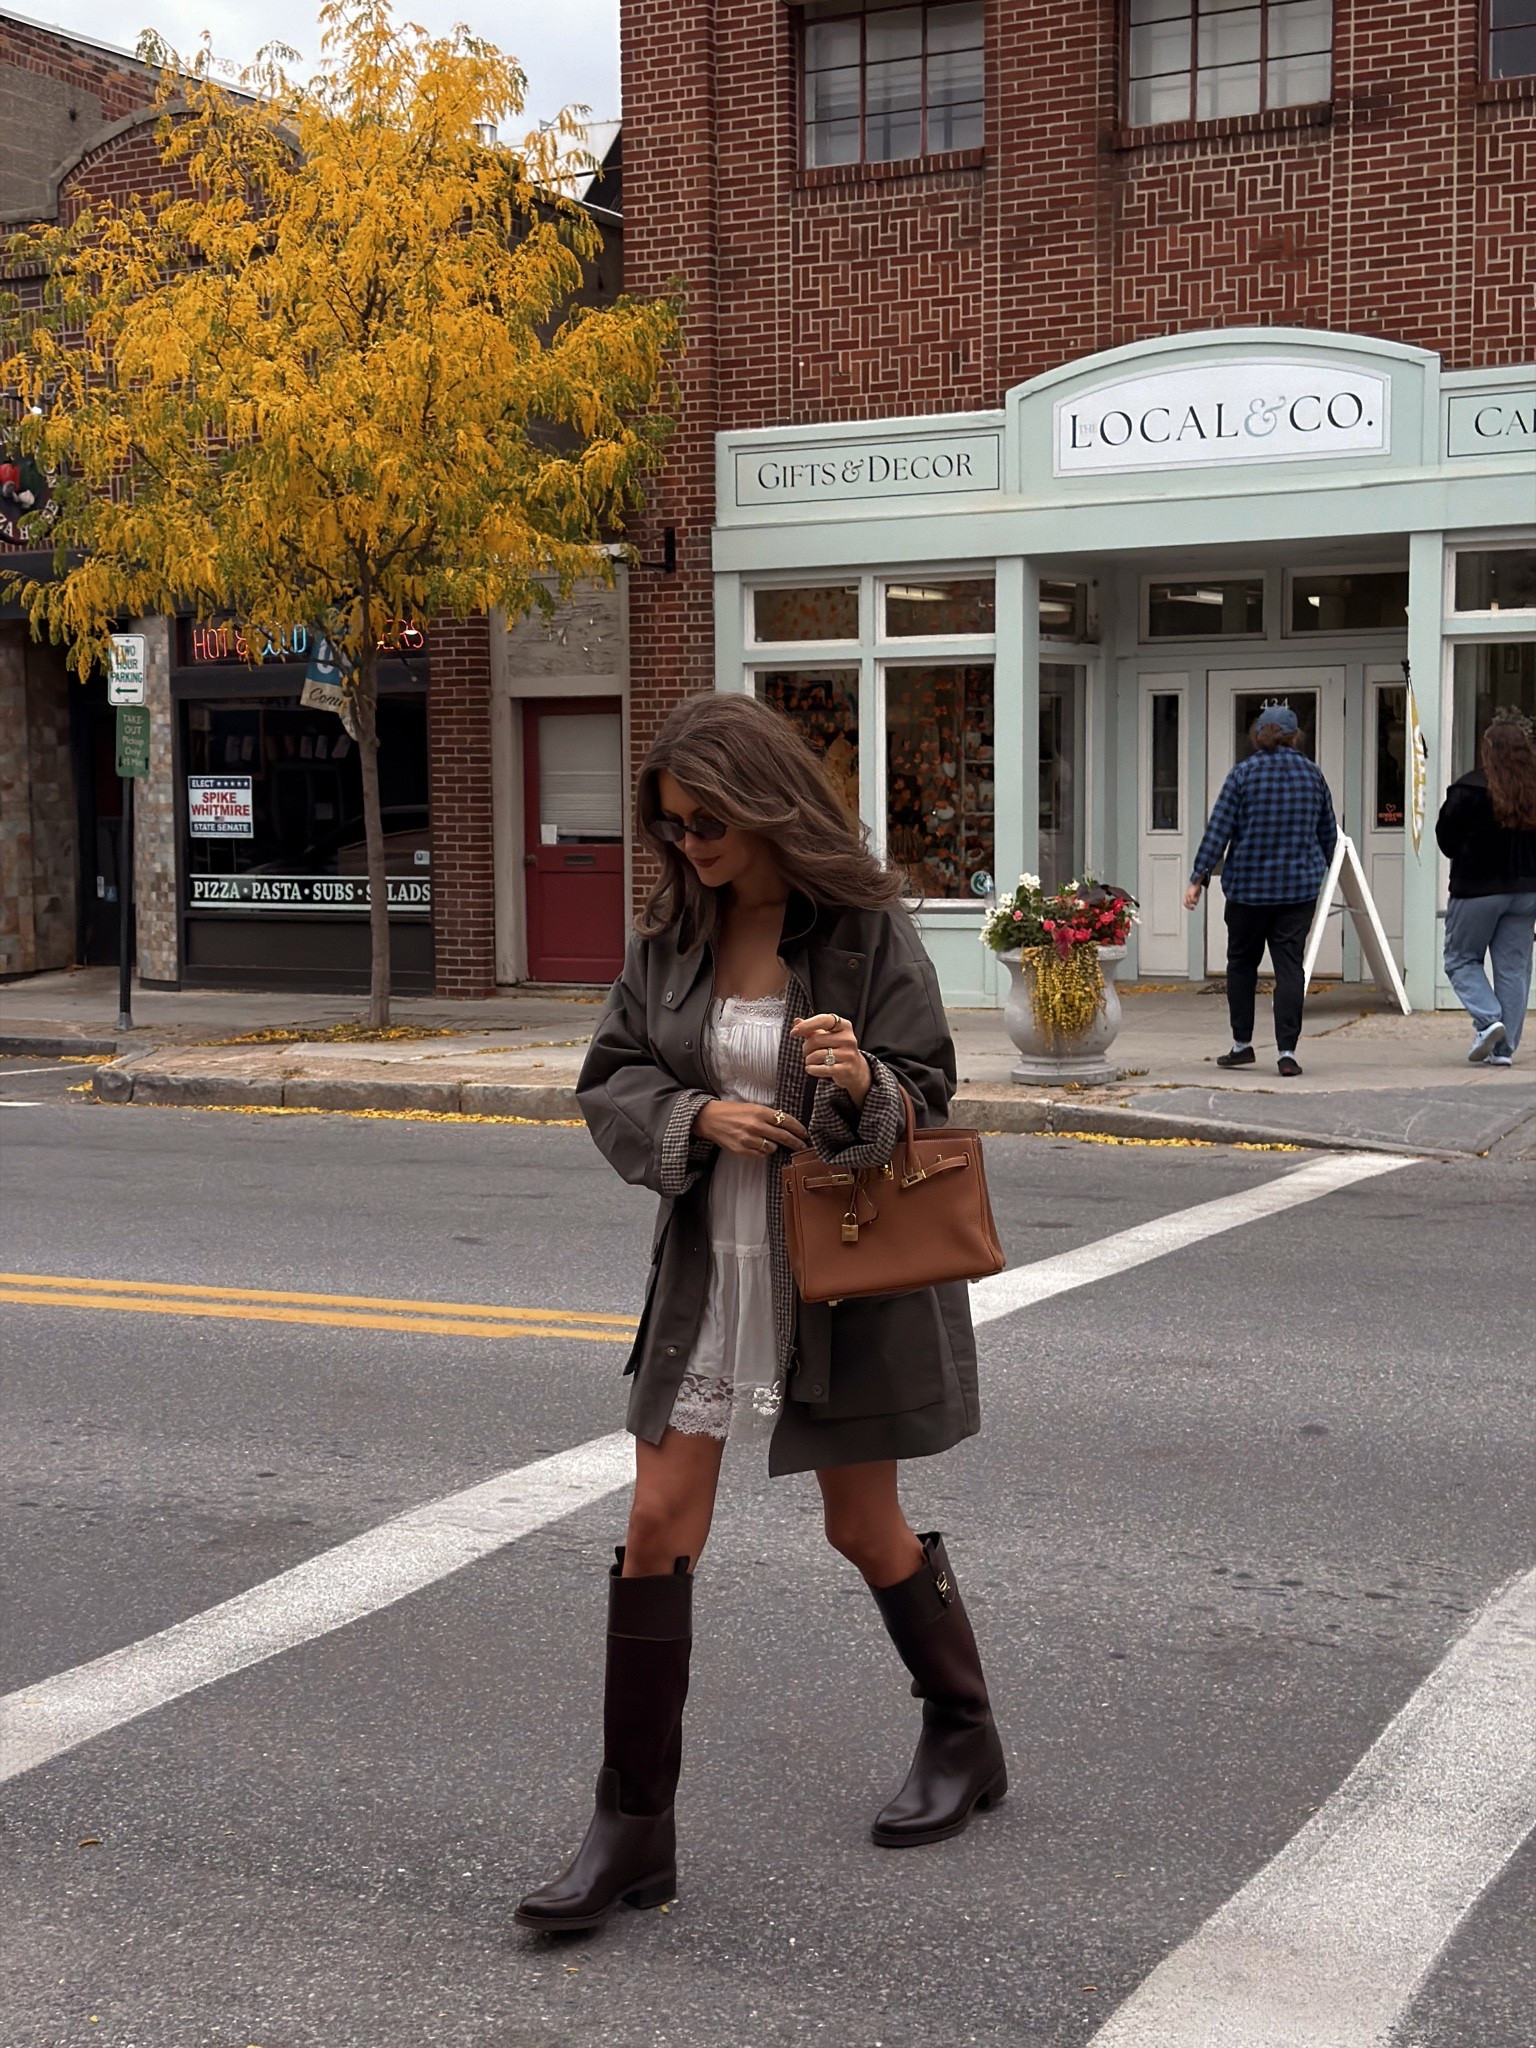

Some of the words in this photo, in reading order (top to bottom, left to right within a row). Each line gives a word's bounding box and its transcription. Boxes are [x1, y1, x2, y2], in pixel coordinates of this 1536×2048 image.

[193, 628, 228, 660] HOT
[117, 659, 138, 670] HOUR
[110, 672, 143, 683] PARKING
[124, 725, 142, 735] OUT
[191, 780, 215, 788] ELECT
[202, 792, 237, 804] SPIKE
[191, 804, 250, 816] WHITMIRE
[193, 823, 216, 831] STATE
[216, 823, 249, 832] SENATE
[193, 881, 240, 899] PIZZA
[252, 881, 302, 900] PASTA
[312, 883, 354, 900] SUBS
[366, 883, 431, 901] SLADS
